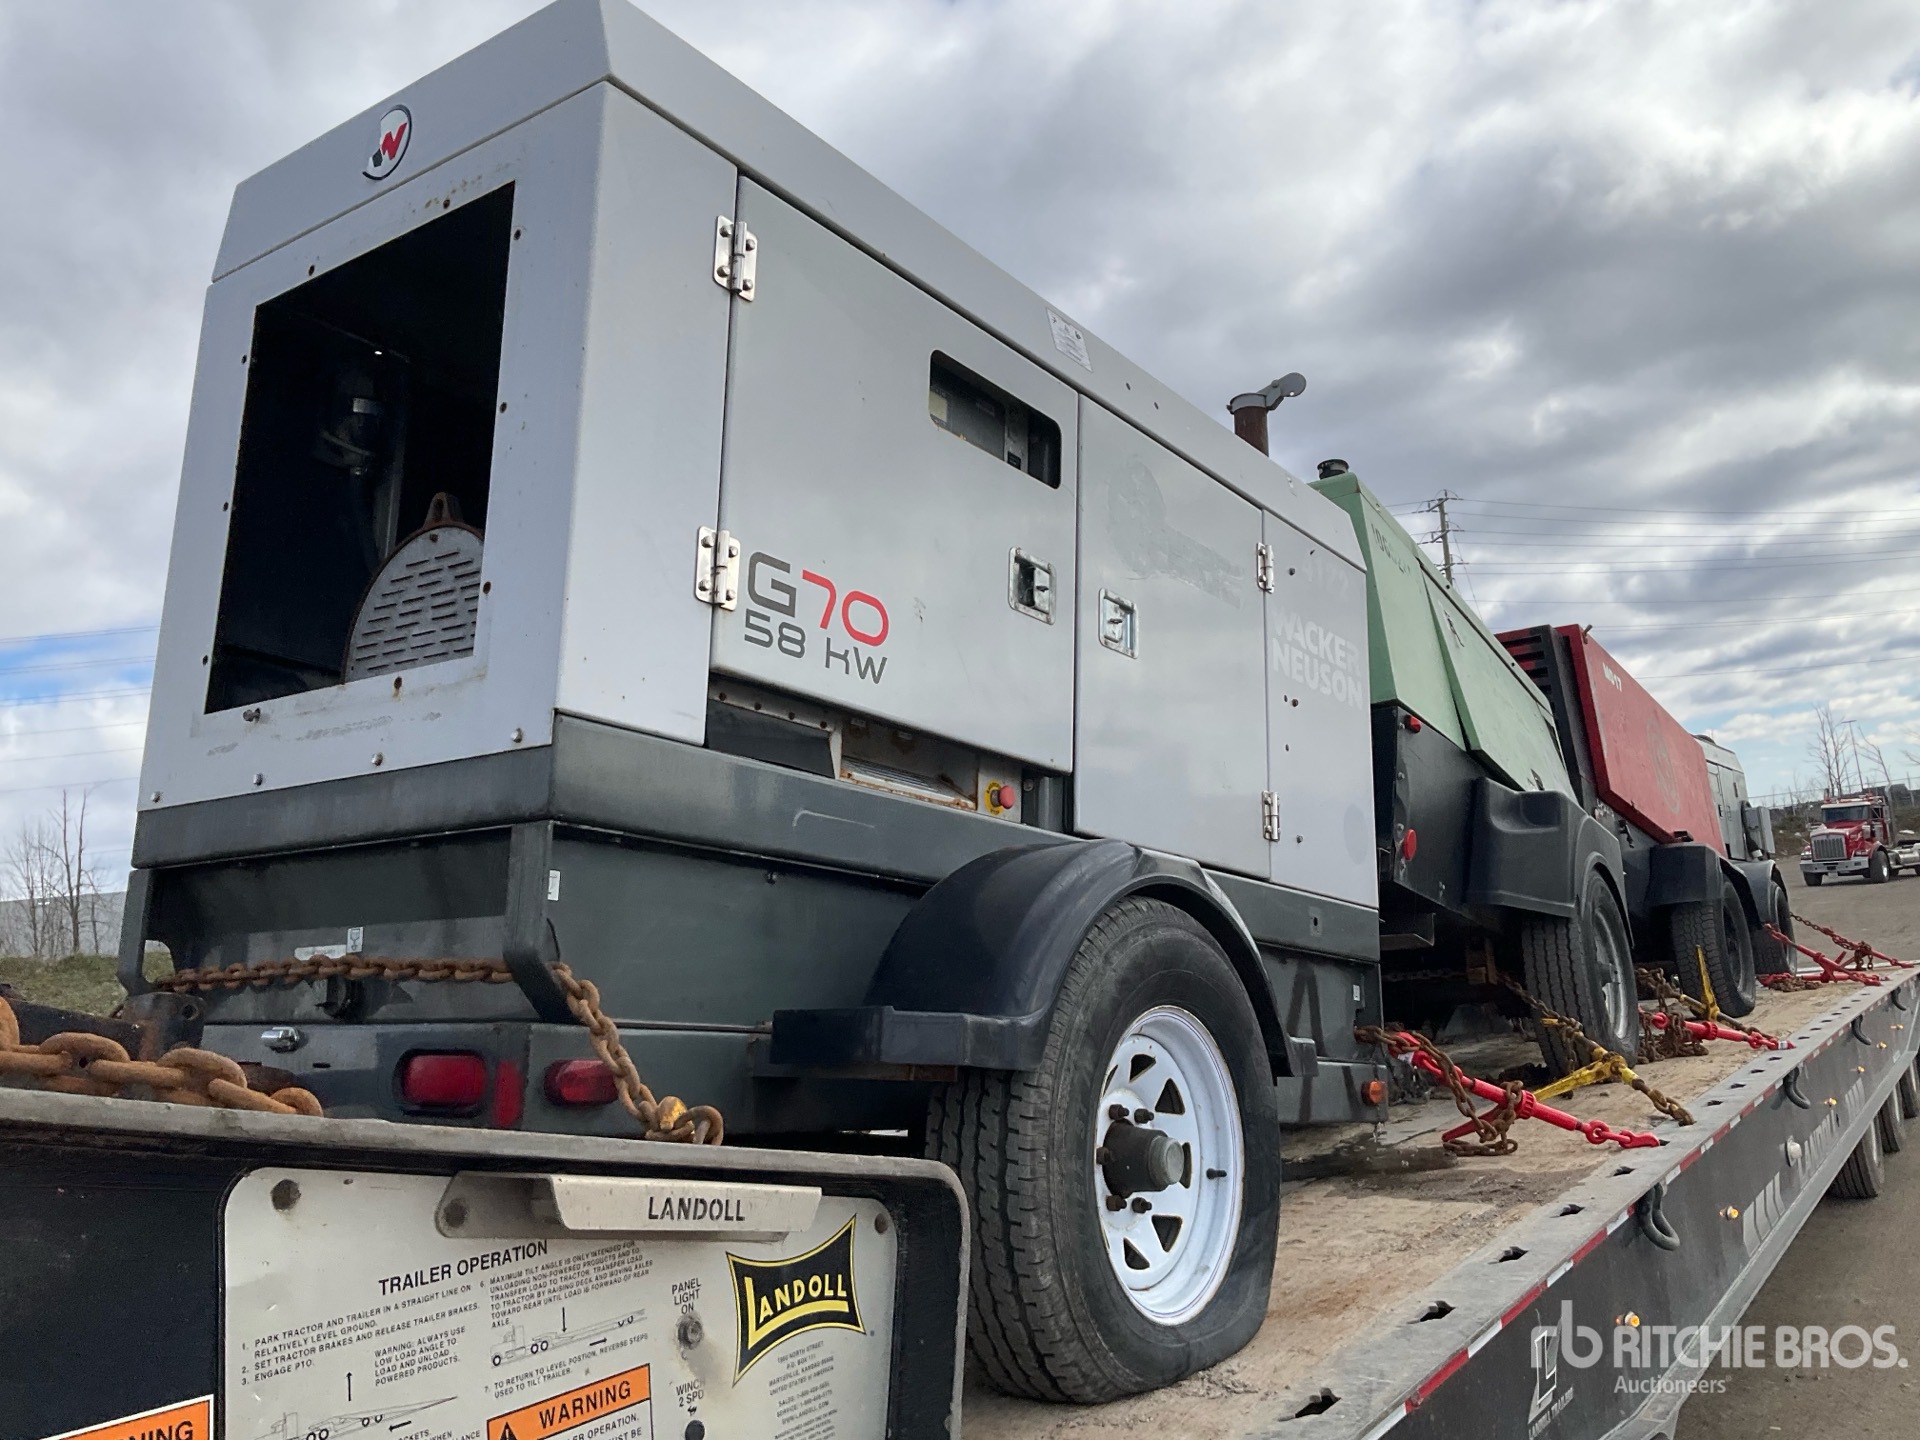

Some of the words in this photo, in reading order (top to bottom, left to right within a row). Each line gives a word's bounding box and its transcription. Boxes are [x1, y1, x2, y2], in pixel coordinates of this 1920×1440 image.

[748, 552, 889, 647] G70
[744, 609, 806, 658] 58
[1271, 606, 1363, 677] WACKER
[1272, 638, 1363, 710] NEUSON
[648, 1196, 745, 1221] LANDOLL
[378, 1264, 451, 1295] TRAILER
[457, 1240, 547, 1275] OPERATION
[490, 1270, 522, 1284] MAXIMUM
[525, 1266, 538, 1275] TILT
[541, 1260, 563, 1271] ANGLE
[572, 1253, 589, 1262] ONLY
[591, 1244, 621, 1257] INTENDED
[490, 1277, 530, 1293] UNLOADING
[582, 1254, 616, 1268] PRODUCTS
[618, 1250, 630, 1259] AND
[490, 1287, 527, 1301] TRANSFER
[529, 1281, 547, 1292] LOAD
[593, 1260, 625, 1273] TRANSFER
[627, 1254, 643, 1264] LOAD
[503, 1293, 534, 1308] TRACTOR
[536, 1290, 545, 1298] BY
[547, 1283, 574, 1294] RAISING
[576, 1277, 592, 1287] DECK
[595, 1272, 607, 1281] AND
[610, 1266, 632, 1277] MOVING
[634, 1260, 653, 1270] AXLES
[491, 1306, 521, 1319] TOWARD
[523, 1300, 541, 1310] REAR
[543, 1295, 562, 1305] UNTIL
[564, 1288, 582, 1299] LOAD
[591, 1277, 622, 1290] FORWARD
[633, 1269, 649, 1278] REAR
[672, 1277, 701, 1294] PANEL
[674, 1289, 700, 1305] LIGHT
[255, 1334, 279, 1347] PARK
[282, 1323, 323, 1339] TRACTOR
[326, 1317, 344, 1328] AND
[347, 1308, 381, 1322] TRAILER
[383, 1305, 391, 1313] IN
[401, 1292, 439, 1308] STRAIGHT
[442, 1288, 459, 1298] LINE
[461, 1284, 471, 1293] ON
[681, 1302, 694, 1314] ON
[744, 1273, 849, 1349] LANDOLL
[241, 1366, 249, 1374] 2.
[254, 1359, 271, 1371] SET
[274, 1347, 316, 1364] TRACTOR
[318, 1334, 353, 1352] BRAKES
[355, 1332, 373, 1342] AND
[375, 1320, 411, 1337] RELEASE
[413, 1312, 446, 1326] TRAILER
[255, 1338, 309, 1359] RELATIVELY
[311, 1330, 338, 1343] LEVEL
[341, 1320, 377, 1335] GROUND.
[374, 1341, 414, 1358] WARNING:
[417, 1330, 449, 1346] ALWAYS
[450, 1326, 465, 1337] USE
[374, 1357, 392, 1368] LOW
[395, 1349, 416, 1362] LOAD
[419, 1341, 444, 1354] ANGLE
[447, 1337, 456, 1346] TO
[241, 1378, 249, 1386] 3.
[254, 1364, 292, 1381] ENGAGE
[375, 1364, 397, 1377] LOAD
[399, 1359, 415, 1370] AND
[417, 1349, 449, 1364] UNLOAD
[375, 1368, 415, 1386] POWERED
[494, 1381, 503, 1389] TO
[506, 1371, 533, 1385] RETURN
[535, 1367, 544, 1375] TO
[546, 1361, 566, 1372] LEVEL
[600, 1340, 628, 1354] REVERSE
[629, 1333, 648, 1345] STEPS
[494, 1386, 513, 1398] USED
[516, 1383, 525, 1391] TO
[527, 1377, 540, 1387] TILT
[539, 1381, 631, 1429] WARNING
[679, 1397, 684, 1407] 2
[686, 1390, 704, 1404] SPD
[587, 1413, 639, 1438] OPERATION.
[631, 1427, 642, 1439] BE
